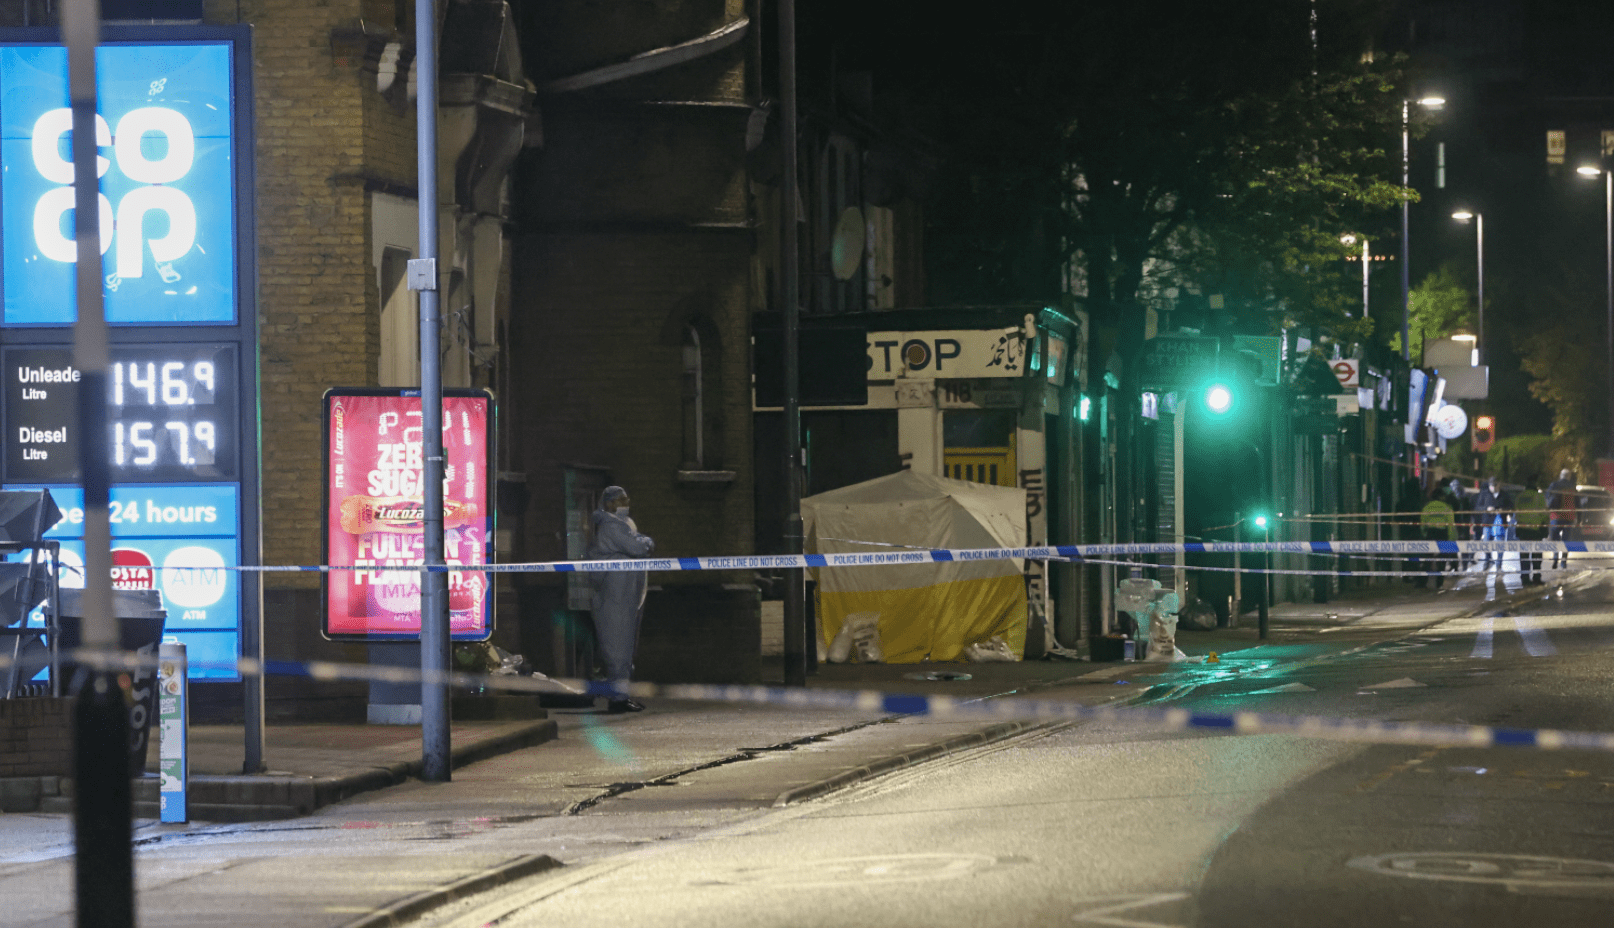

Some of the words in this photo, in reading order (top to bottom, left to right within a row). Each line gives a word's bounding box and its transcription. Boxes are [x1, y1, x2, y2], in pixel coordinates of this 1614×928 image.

[18, 366, 81, 384] Unleade
[114, 361, 215, 405] 146.9
[22, 388, 47, 400] Litre
[19, 427, 67, 443] Diesel
[334, 409, 345, 456] Lucozade
[114, 421, 215, 465] 157.9
[23, 448, 48, 460] Litre
[377, 443, 423, 470] ZER
[109, 501, 139, 522] 24
[147, 499, 216, 522] hours
[1086, 547, 1108, 555] POLICE
[1111, 546, 1125, 554] LINE
[1127, 546, 1137, 554] DO
[1139, 546, 1151, 554] NOT
[1153, 545, 1176, 553] CROSS
[1213, 544, 1234, 552] POLICE
[1280, 544, 1302, 552] CROSS
[1340, 543, 1361, 551] POLICE
[1364, 543, 1378, 551] LINE
[1381, 543, 1390, 551] DO
[1392, 543, 1404, 551] NOT
[1407, 543, 1429, 551] CROSS
[1467, 543, 1489, 551] POLICE
[1492, 543, 1506, 551] LINE
[1508, 543, 1518, 551] DO
[1520, 543, 1531, 551] NOT
[1535, 543, 1558, 551] CROSS
[833, 555, 857, 564] POLICE
[858, 554, 874, 564] LINE
[874, 554, 885, 563] DO
[886, 553, 899, 563] NOT
[901, 553, 924, 562] CROSS
[960, 551, 983, 560] POLICE
[984, 550, 999, 559] LINE
[1001, 549, 1011, 558] DO
[1012, 549, 1025, 558] NOT
[1027, 548, 1049, 556] CROSS
[606, 562, 621, 570] LINE
[634, 561, 647, 569] NOT
[649, 560, 671, 569] CROSS
[708, 558, 731, 568] POLICE
[732, 558, 747, 567] LINE
[749, 557, 759, 567] DO
[761, 557, 773, 567] NOT
[775, 556, 797, 566] CROSS
[110, 568, 149, 581] OSTA
[171, 568, 219, 586] ATM
[112, 581, 149, 591] XPRESS
[182, 610, 206, 620] ATM
